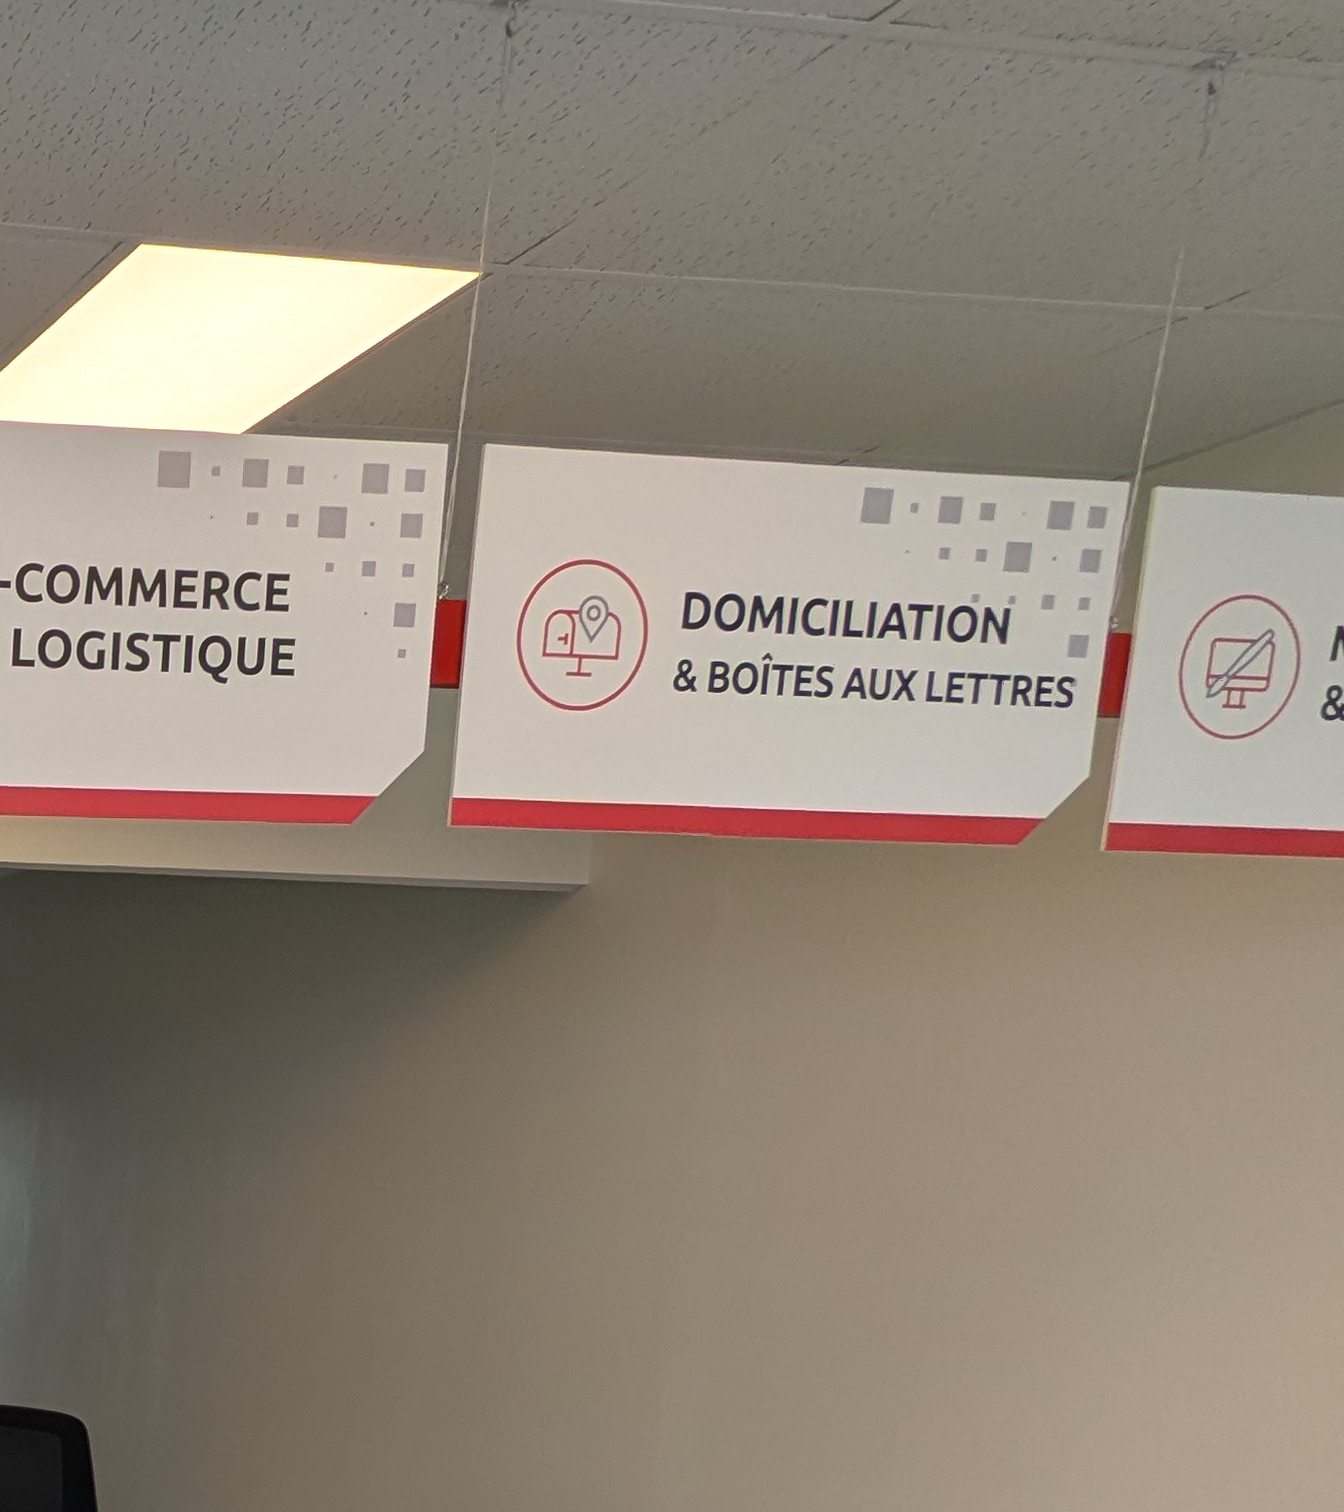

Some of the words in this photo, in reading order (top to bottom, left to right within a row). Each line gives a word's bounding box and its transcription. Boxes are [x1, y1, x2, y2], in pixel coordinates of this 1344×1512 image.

[681, 590, 1012, 645] DOMICILIATION
[11, 627, 296, 684] LOGISTIQUE
[672, 658, 698, 693] &
[707, 652, 835, 700] BOÎTES
[841, 667, 919, 701] AUX
[925, 671, 1077, 709] LETTRES
